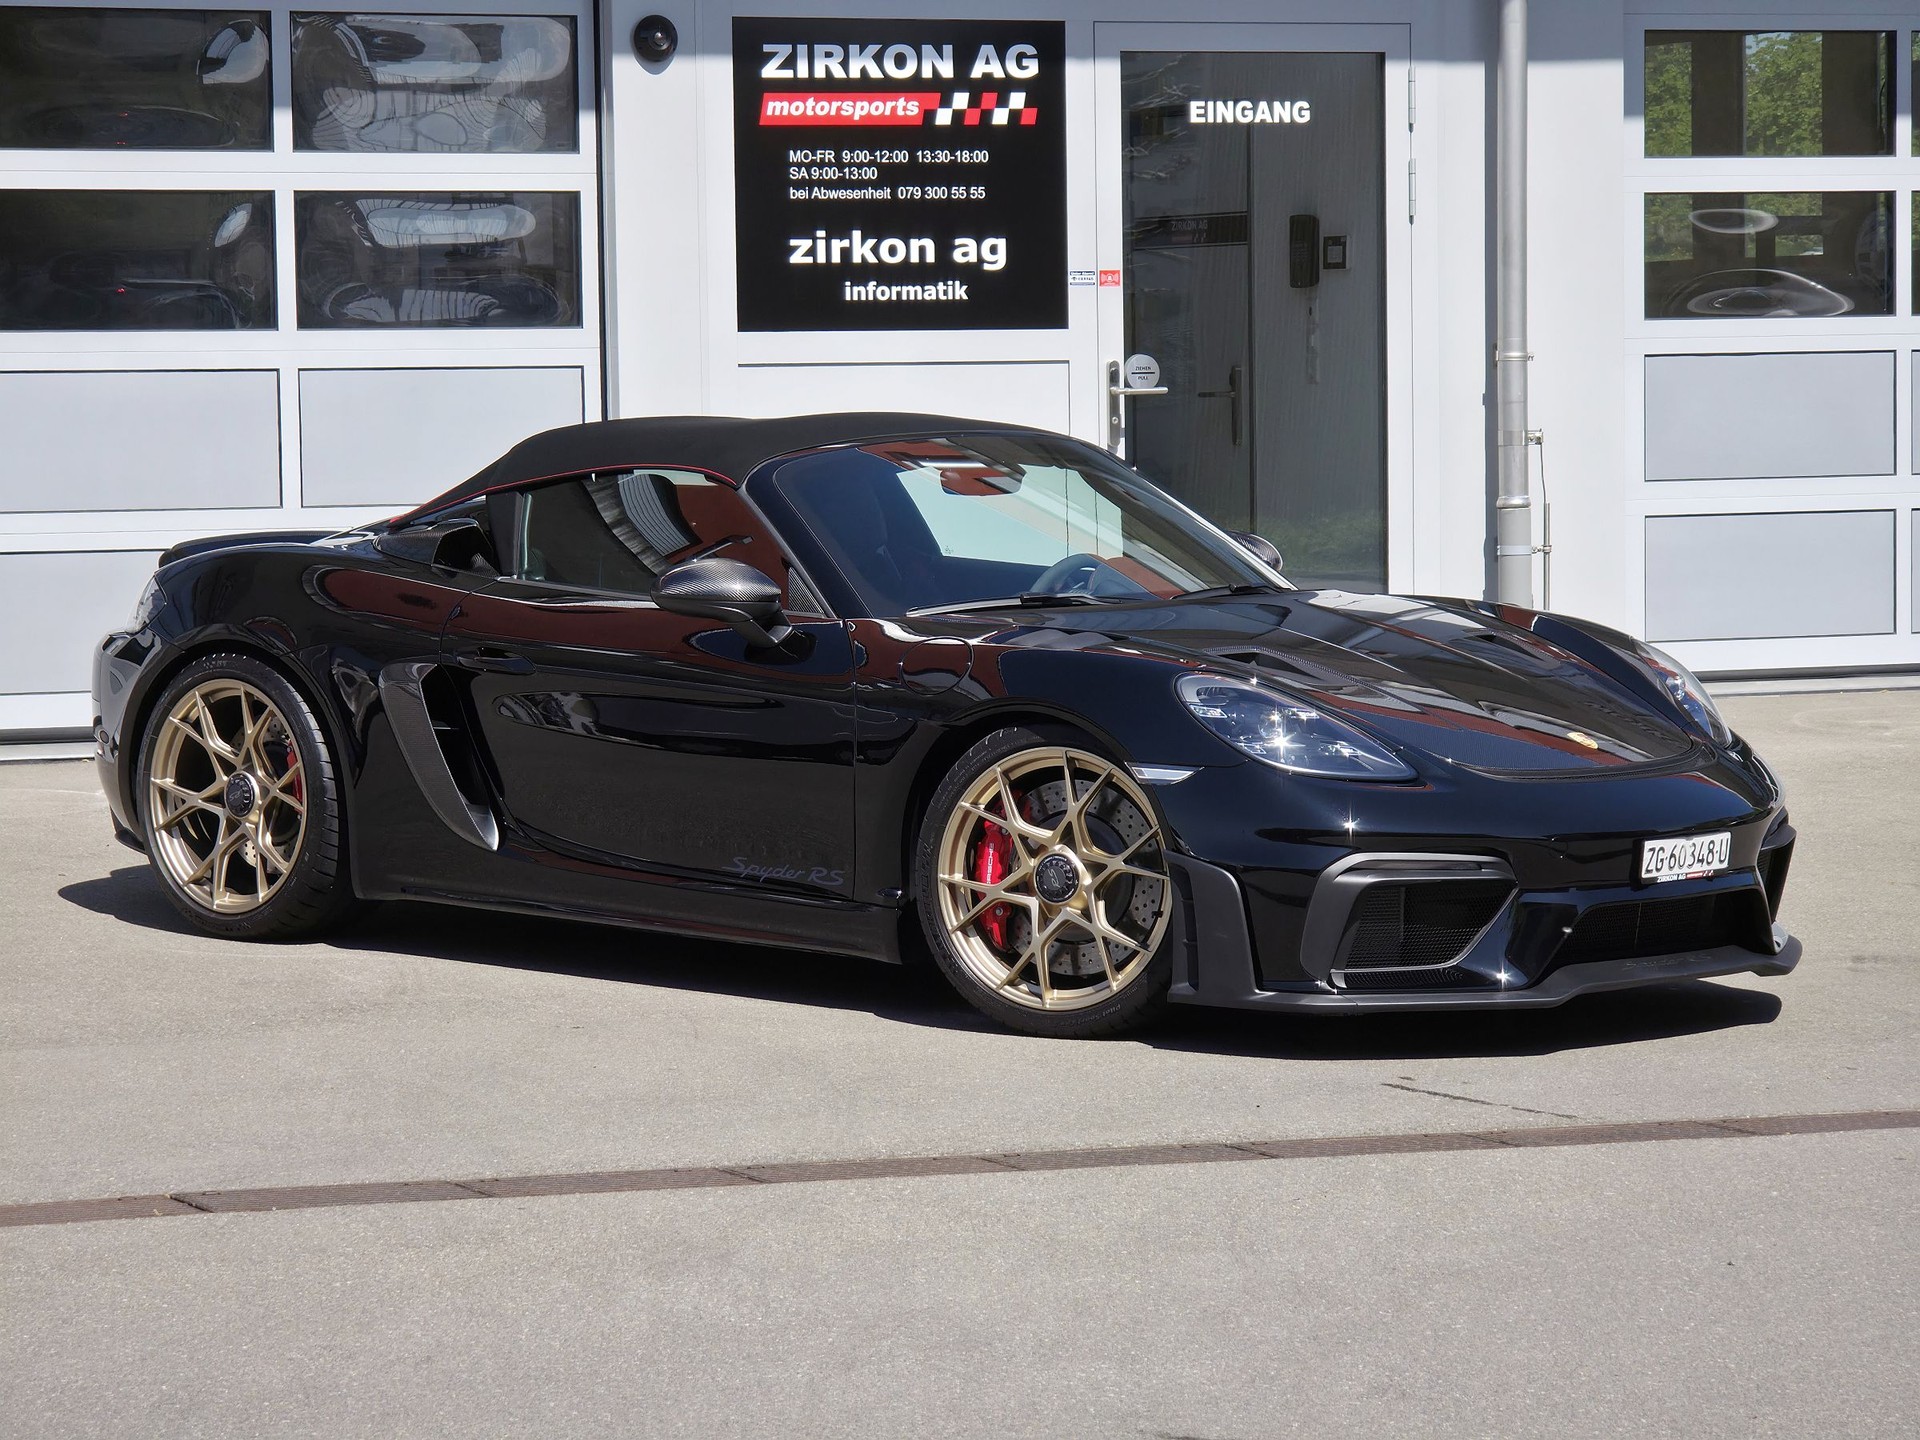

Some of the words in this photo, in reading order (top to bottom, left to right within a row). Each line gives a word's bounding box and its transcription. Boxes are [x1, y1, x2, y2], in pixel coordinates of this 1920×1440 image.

[761, 44, 954, 79] ZIRKON
[970, 44, 1039, 79] AG
[767, 97, 919, 120] motorsports
[1189, 101, 1310, 123] EINGANG
[790, 150, 835, 162] MO-FR
[842, 150, 908, 162] 9:00-12:00
[917, 150, 988, 162] 13:30-18:00
[790, 167, 809, 179] SA
[811, 167, 877, 179] 9:00-13:00
[790, 187, 808, 199] bei
[811, 187, 891, 199] Abwesenheit
[898, 187, 921, 199] 079
[925, 187, 947, 199] 300
[951, 187, 966, 199] 55
[970, 187, 985, 199] 55
[789, 230, 935, 263] zirkon
[953, 238, 1006, 271] ag
[845, 281, 968, 300] informatik
[722, 857, 805, 882] Spyder
[808, 867, 845, 885] RS
